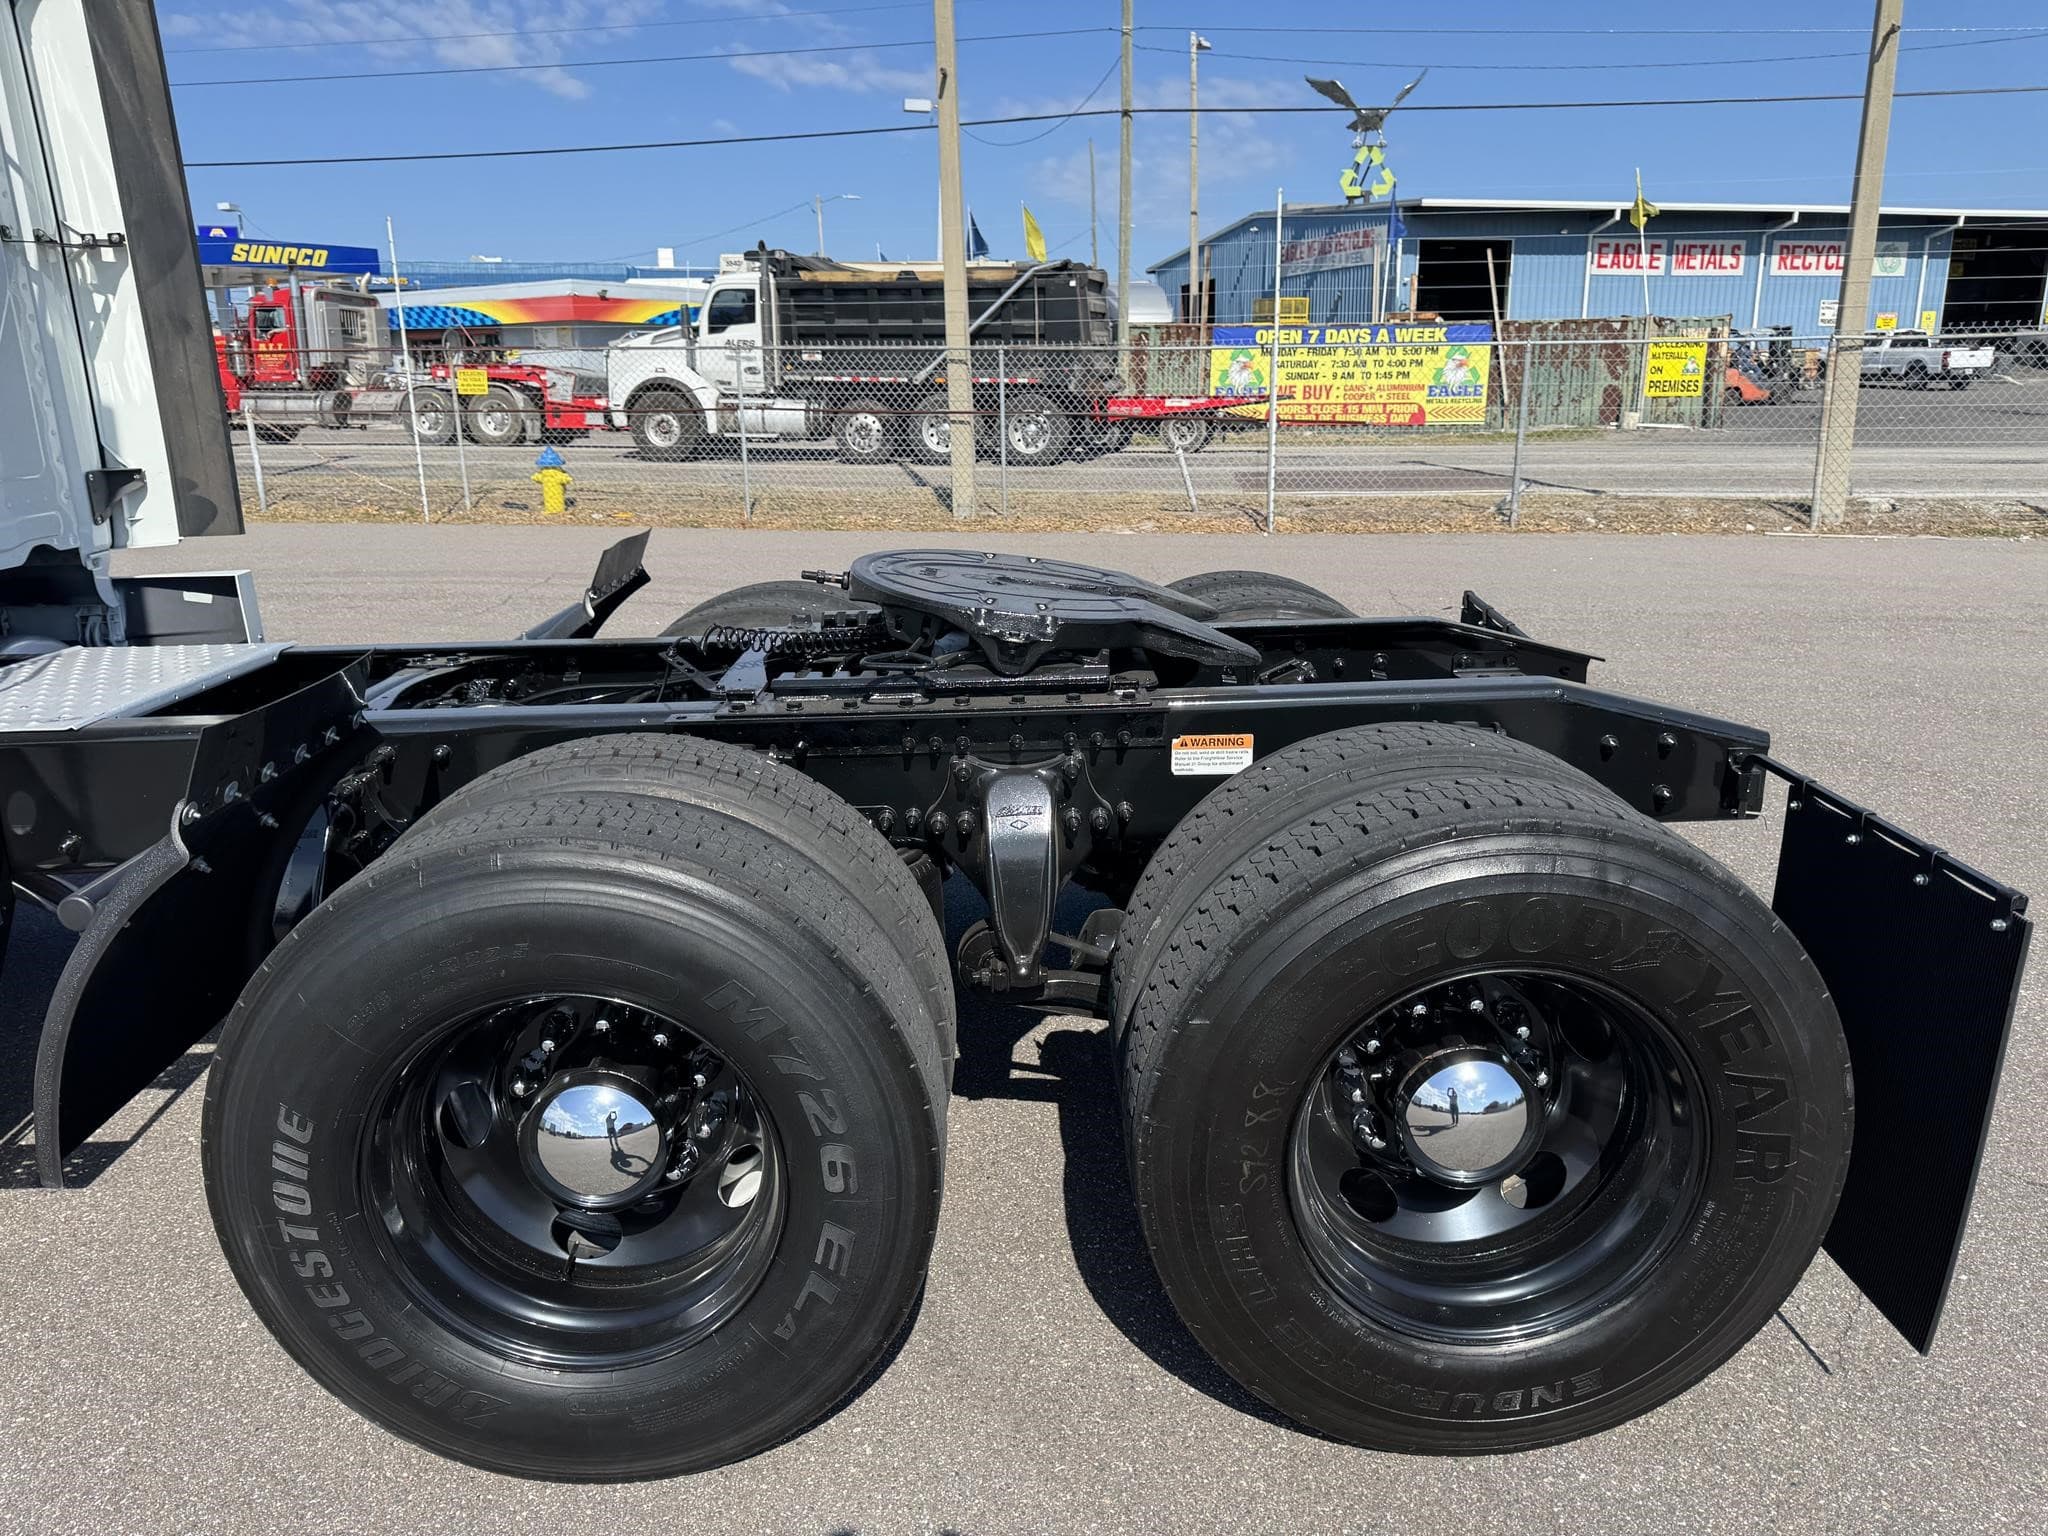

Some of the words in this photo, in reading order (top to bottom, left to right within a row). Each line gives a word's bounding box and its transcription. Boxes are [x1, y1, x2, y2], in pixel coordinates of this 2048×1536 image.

[231, 243, 328, 267] SUNOCO
[1596, 242, 1662, 270] EAGLE
[1674, 243, 1742, 270] METALS
[1777, 244, 1845, 270] RECYCL
[1255, 328, 1303, 344] OPEN
[1307, 329, 1320, 344] 7
[1325, 328, 1372, 344] DAYS
[1375, 328, 1390, 343] A
[1395, 327, 1448, 343] WEEK
[1306, 346, 1337, 357] FRIDAY
[1344, 346, 1361, 356] 7:30
[1365, 346, 1379, 356] AM
[1386, 346, 1396, 356] TO
[1402, 346, 1422, 356] 5:00
[1425, 346, 1439, 355] PM
[1651, 351, 1689, 360] MATERIALS
[1331, 359, 1350, 369] 7:30
[1353, 359, 1367, 368] AM
[1373, 359, 1384, 368] TO
[1387, 359, 1407, 368] 4:00
[1409, 359, 1424, 367] PM
[1285, 371, 1319, 380] SUNDAY
[1332, 372, 1338, 380] 9
[1340, 371, 1355, 380] AM
[1360, 371, 1371, 380] TO
[1375, 371, 1393, 380] 1:45
[1396, 371, 1410, 379] PM
[1649, 366, 1664, 375] ON
[1343, 384, 1366, 392] CANS
[1427, 385, 1483, 397] EAGLE
[1648, 379, 1700, 393] PREMISES
[1302, 384, 1333, 400] BUY
[1386, 392, 1410, 400] STEEL
[1310, 404, 1344, 414] CLOSE
[1346, 404, 1360, 414] 15
[1386, 403, 1418, 413] PRIOR
[1389, 413, 1412, 423] DAY
[1190, 737, 1245, 747] WARNING
[1379, 896, 1794, 1185] GOODYEAR
[703, 979, 861, 1195] M726
[271, 1102, 511, 1429] BRIDGESTONE
